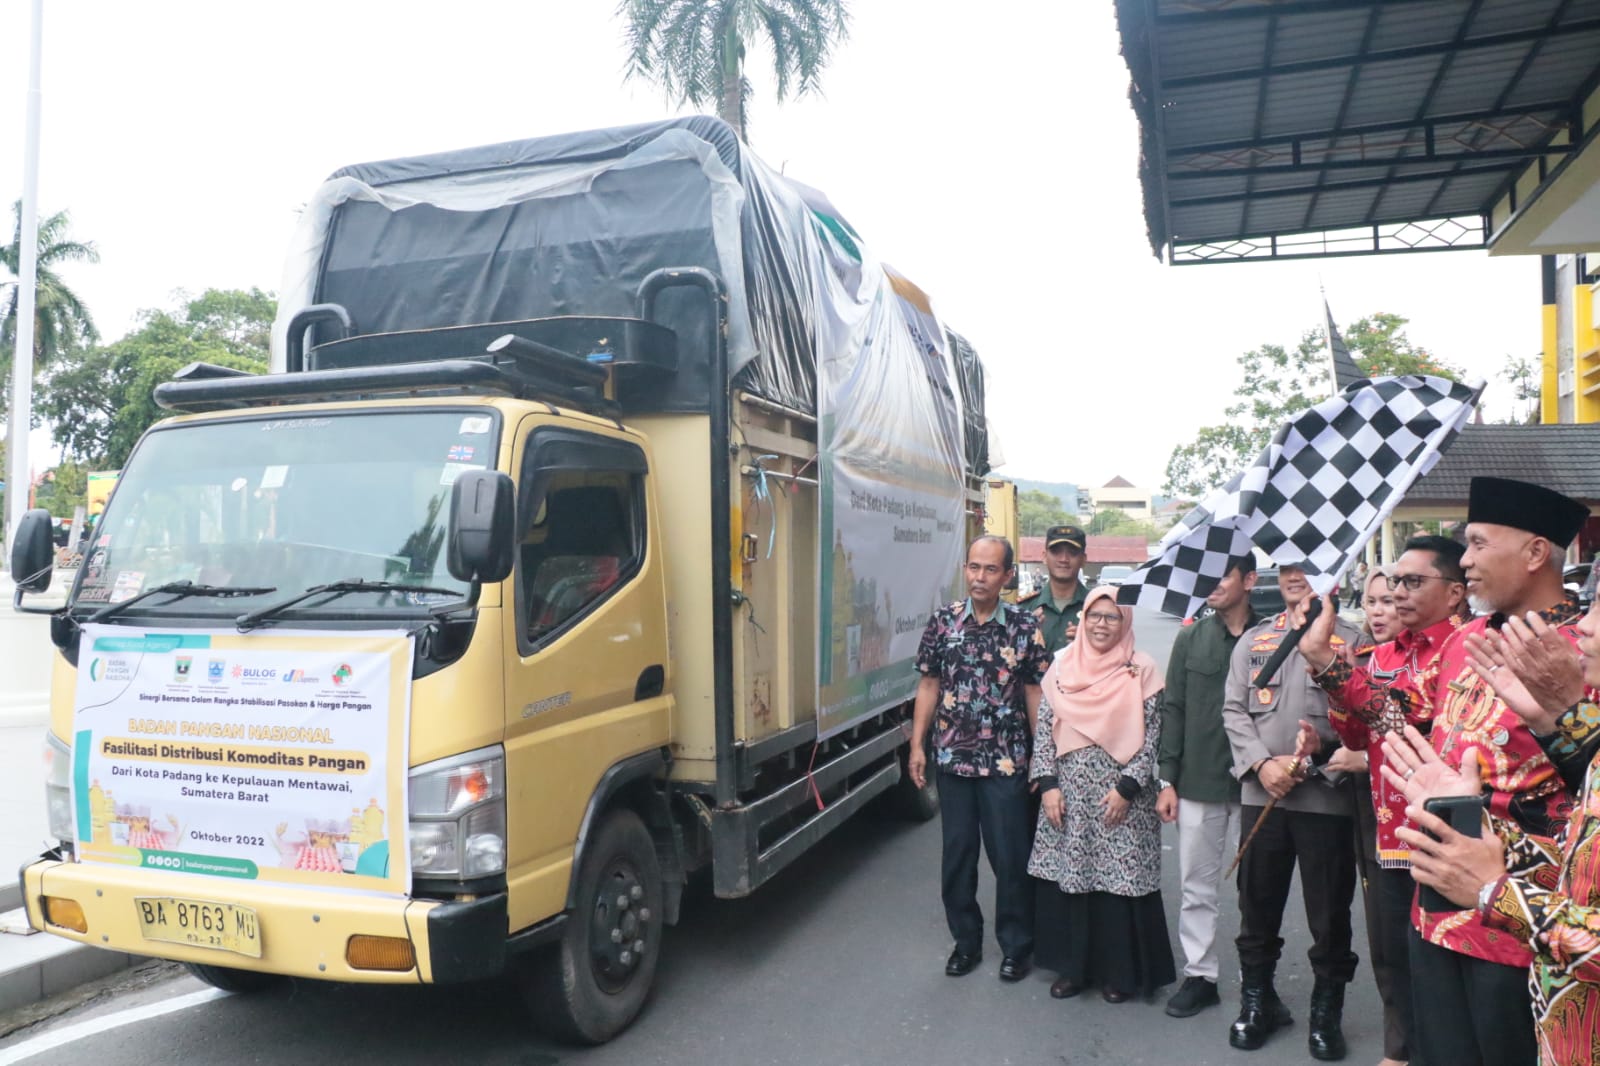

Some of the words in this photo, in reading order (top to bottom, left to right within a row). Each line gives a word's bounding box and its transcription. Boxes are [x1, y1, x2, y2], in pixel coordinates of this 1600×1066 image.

[866, 492, 882, 513] Kota
[883, 496, 904, 520] Padang
[243, 668, 277, 678] BULOG
[139, 693, 161, 704] Sinergi
[162, 694, 190, 703] Bersama
[191, 696, 213, 704] Dalam
[214, 697, 239, 707] Rangka
[240, 698, 276, 707] Stabilisasi
[277, 699, 308, 708] Pasokan
[310, 701, 316, 709] &
[317, 701, 341, 710] Harga
[342, 702, 372, 712] Pangan
[128, 718, 177, 735] BADAN
[181, 720, 245, 739] PANGAN
[248, 724, 334, 744] NASIONAL
[103, 741, 158, 757] Fasilitasi
[161, 745, 223, 761] Distribusi
[227, 750, 304, 766] Komoditas
[308, 755, 366, 772] Pangan
[112, 766, 133, 777] Dari
[135, 767, 159, 779] Kota
[162, 769, 202, 784] Padang
[206, 772, 219, 783] ke
[222, 774, 285, 788] Kepulauan
[288, 778, 353, 794] Mentawai,
[181, 786, 234, 800] Sumatera
[238, 790, 269, 803] Barat
[190, 830, 233, 844] Oktober
[235, 834, 265, 847] 2022
[140, 901, 167, 926] BA
[177, 902, 225, 932] 8763
[236, 910, 255, 940] MU
